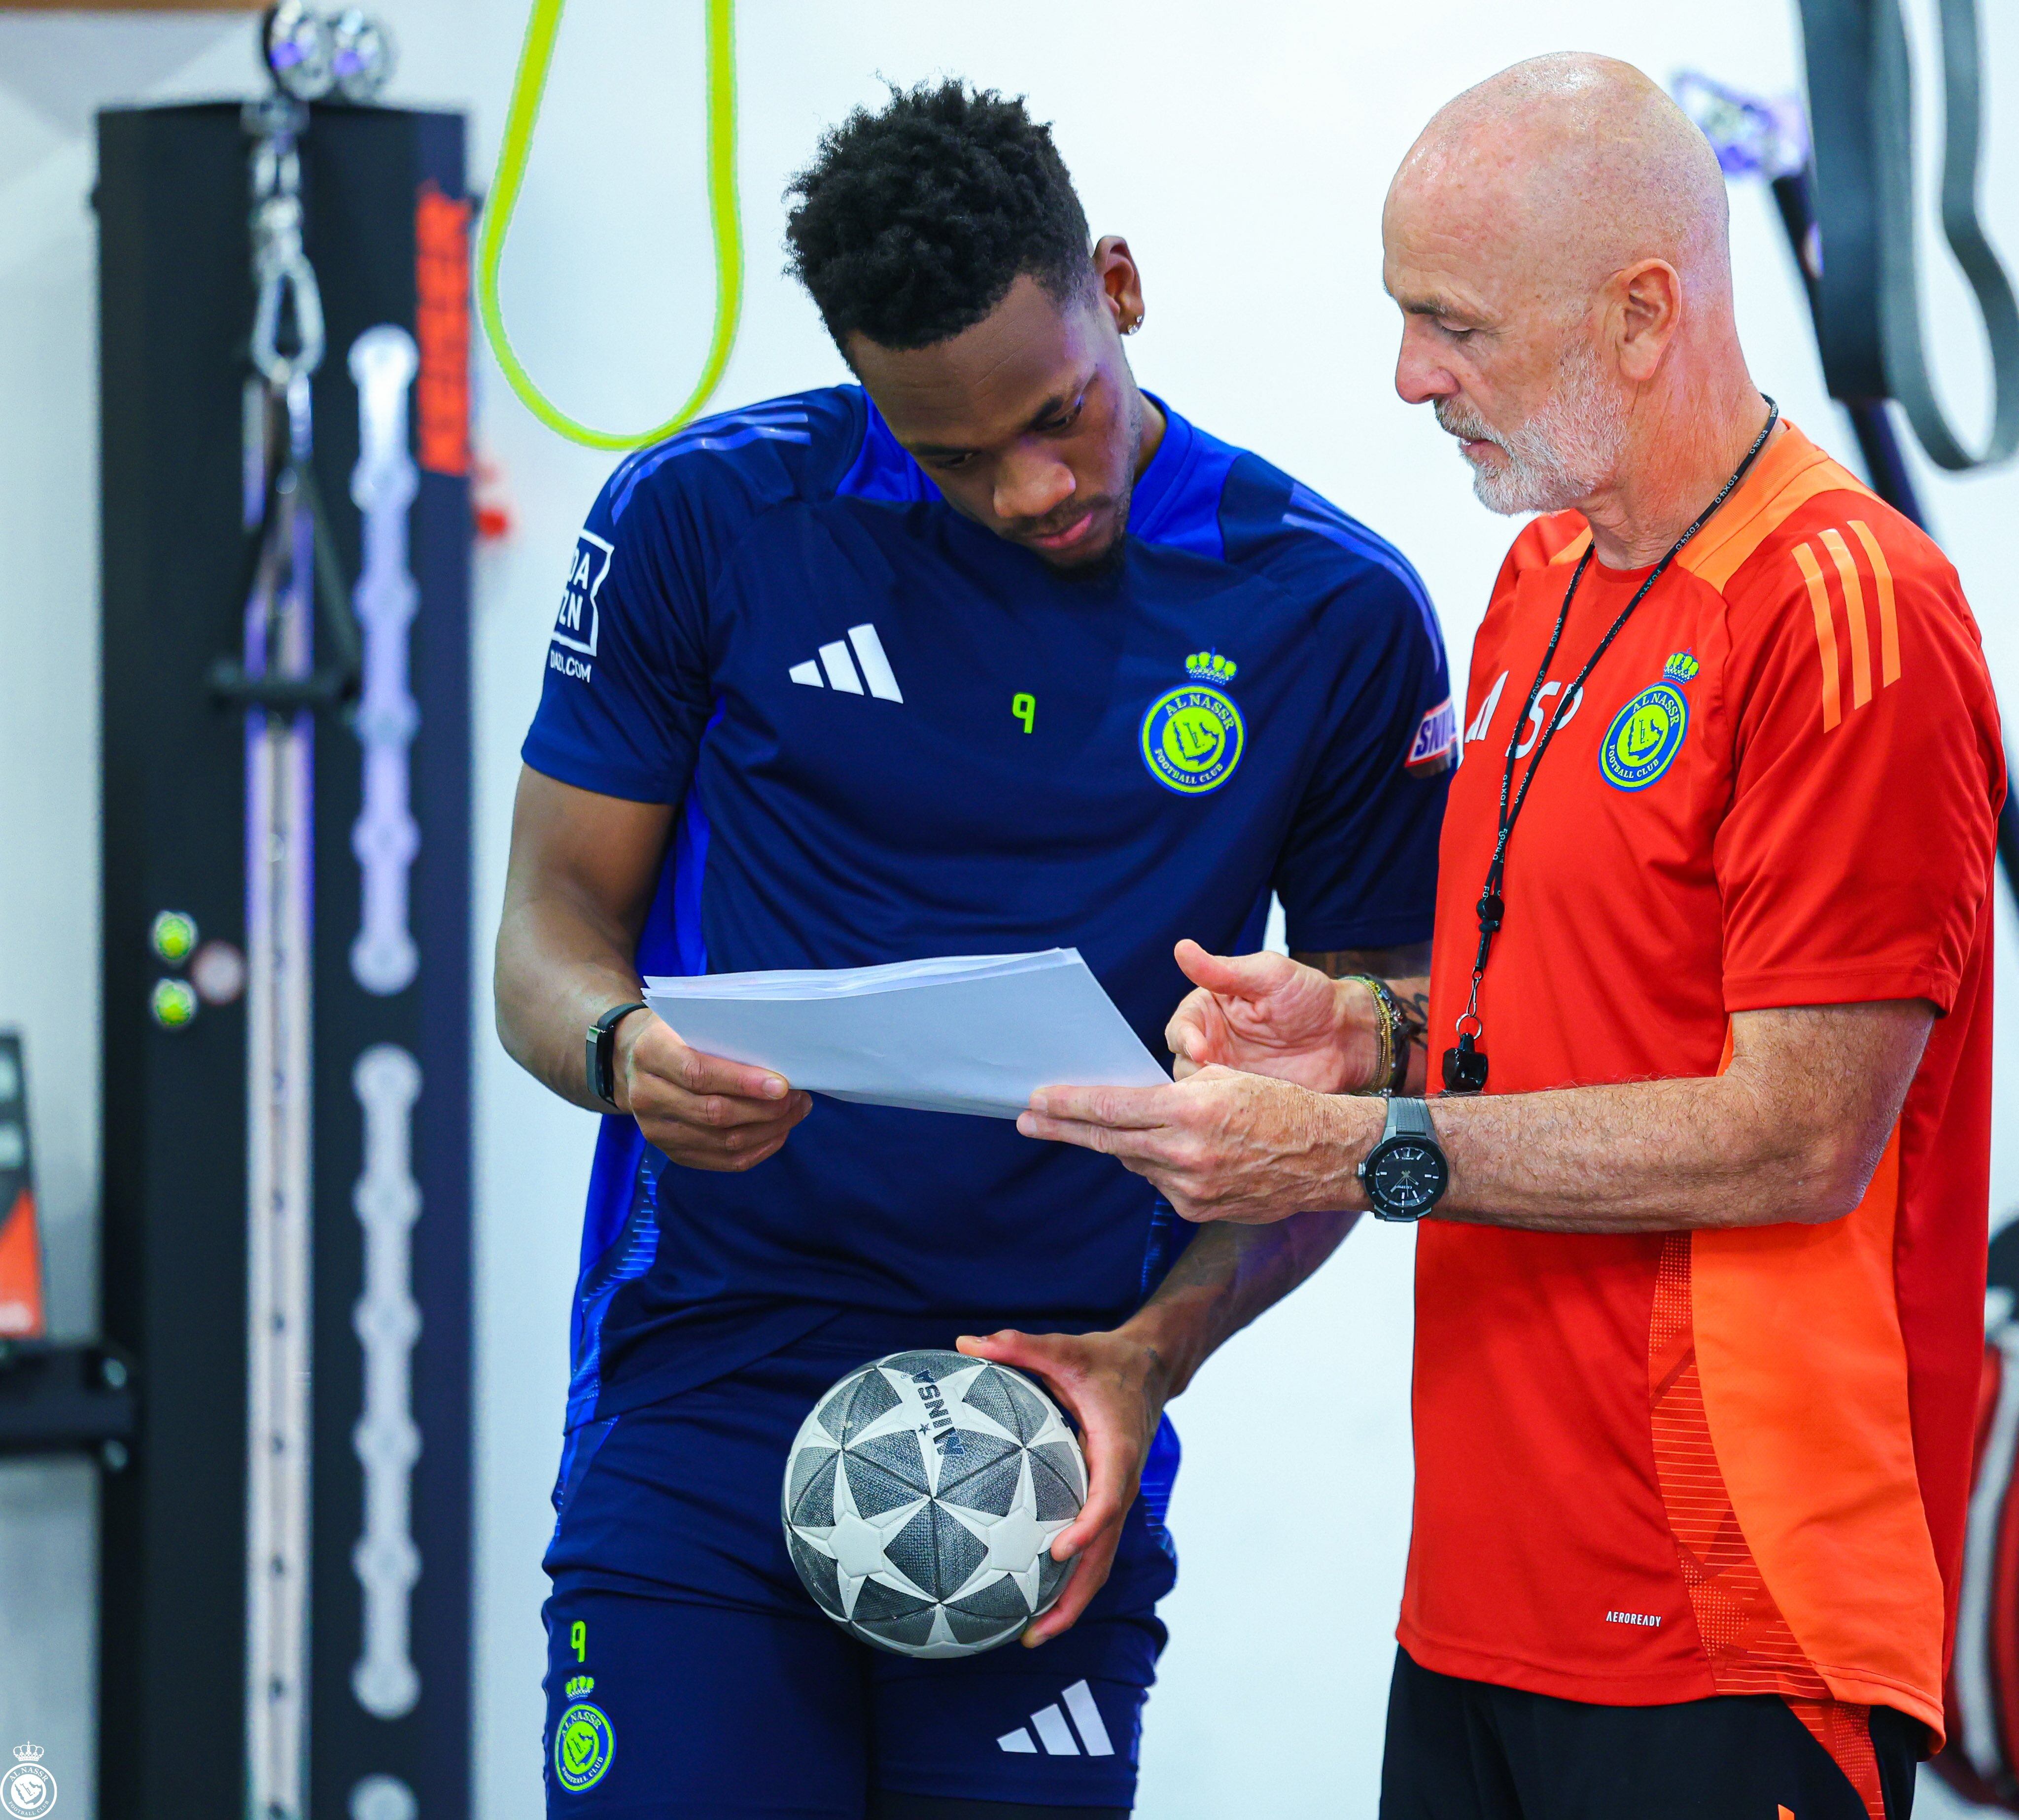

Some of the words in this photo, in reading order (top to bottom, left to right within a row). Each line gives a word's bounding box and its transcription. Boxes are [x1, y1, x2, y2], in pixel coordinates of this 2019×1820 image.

[1715, 475, 1739, 504] FOX40
[1676, 522, 1700, 550] FOX40
[1012, 693, 1036, 734] 9
[1165, 698, 1187, 717] AL
[1188, 694, 1235, 731] NASSR
[1632, 696, 1649, 714] AL
[1651, 693, 1679, 727] NASSR
[1155, 748, 1197, 784] FOOTBALL
[1199, 763, 1224, 783] CLUB
[1608, 743, 1635, 779] FOOTBALL
[1636, 759, 1659, 778] CLUB
[911, 1368, 965, 1455] MINSA
[1605, 1610, 1662, 1627] AEROREADY
[570, 1620, 586, 1663] 9
